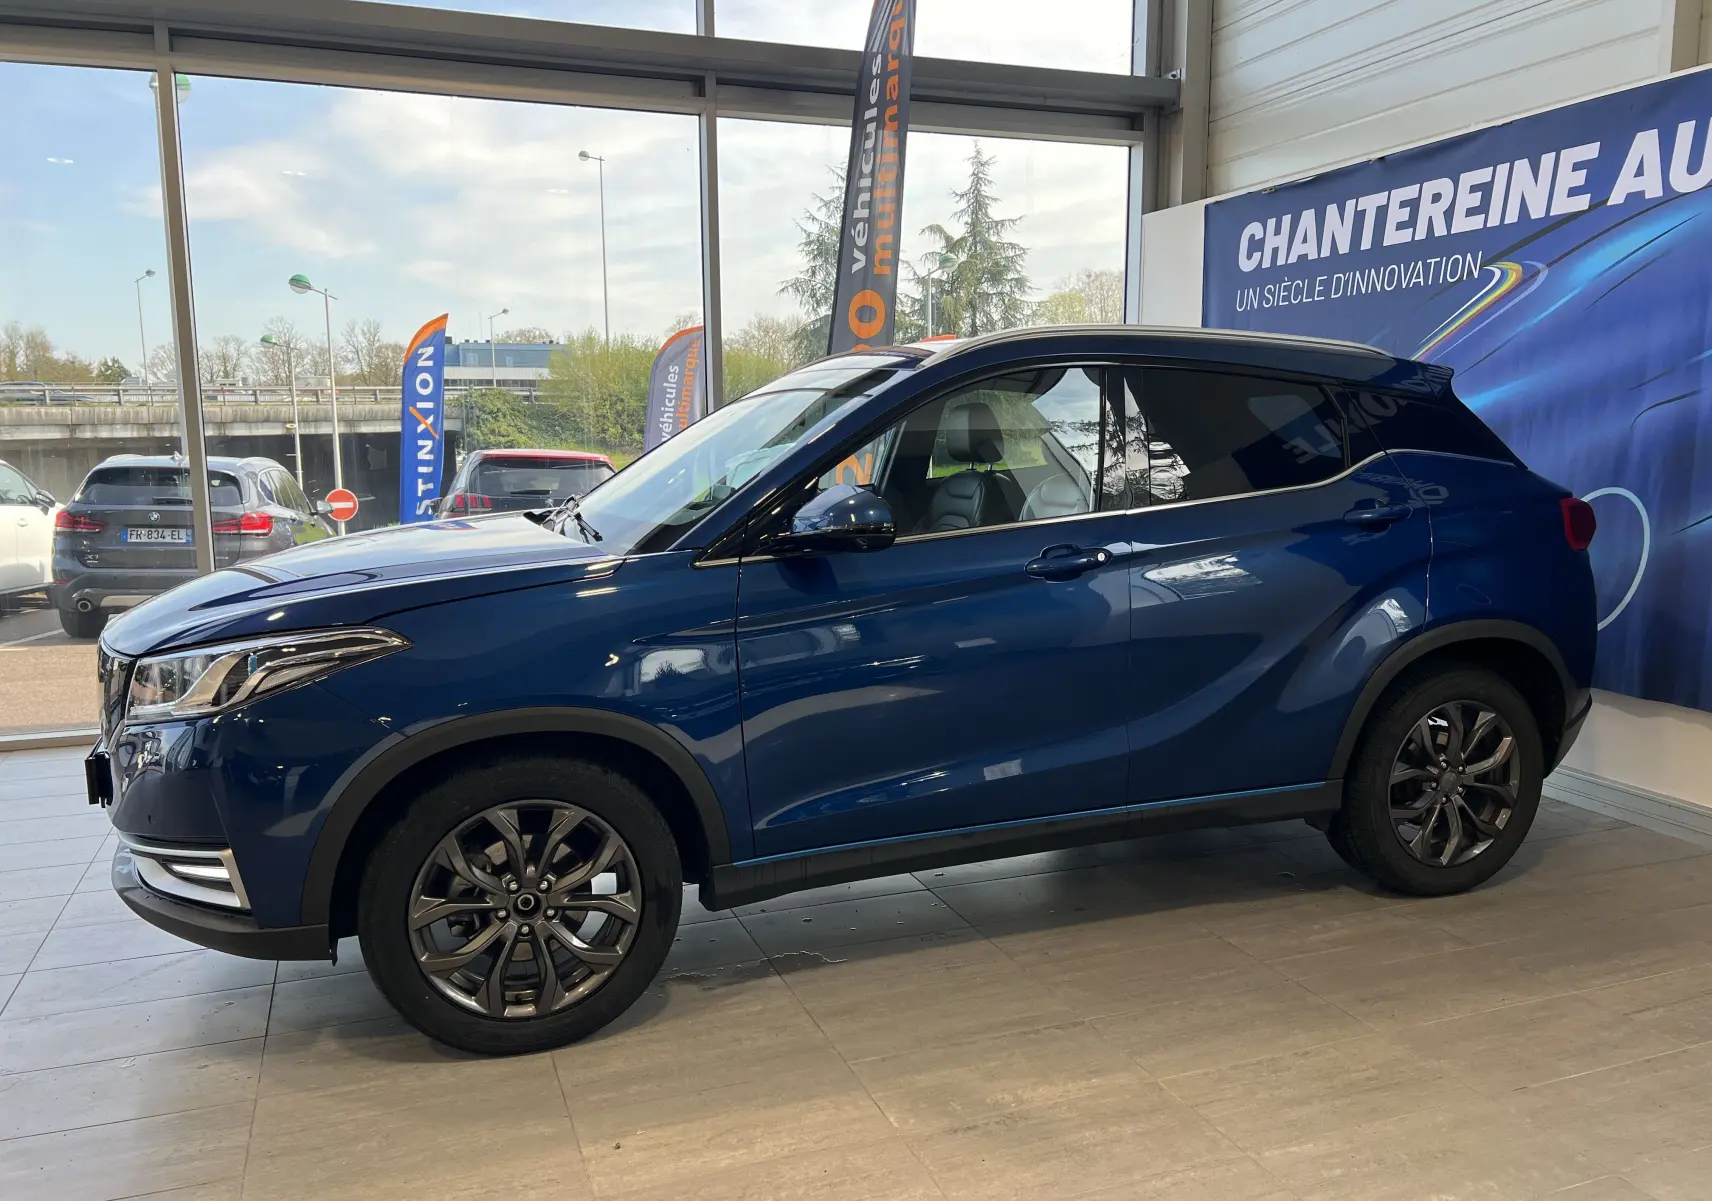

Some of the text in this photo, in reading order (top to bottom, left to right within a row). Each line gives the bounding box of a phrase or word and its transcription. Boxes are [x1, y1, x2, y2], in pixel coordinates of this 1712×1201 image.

[851, 53, 882, 274] véhicules
[1238, 141, 1601, 272] CHANTEREINE
[1236, 250, 1483, 312] UN SIÈCLE D'INNOVATION
[659, 365, 679, 442] véhicules
